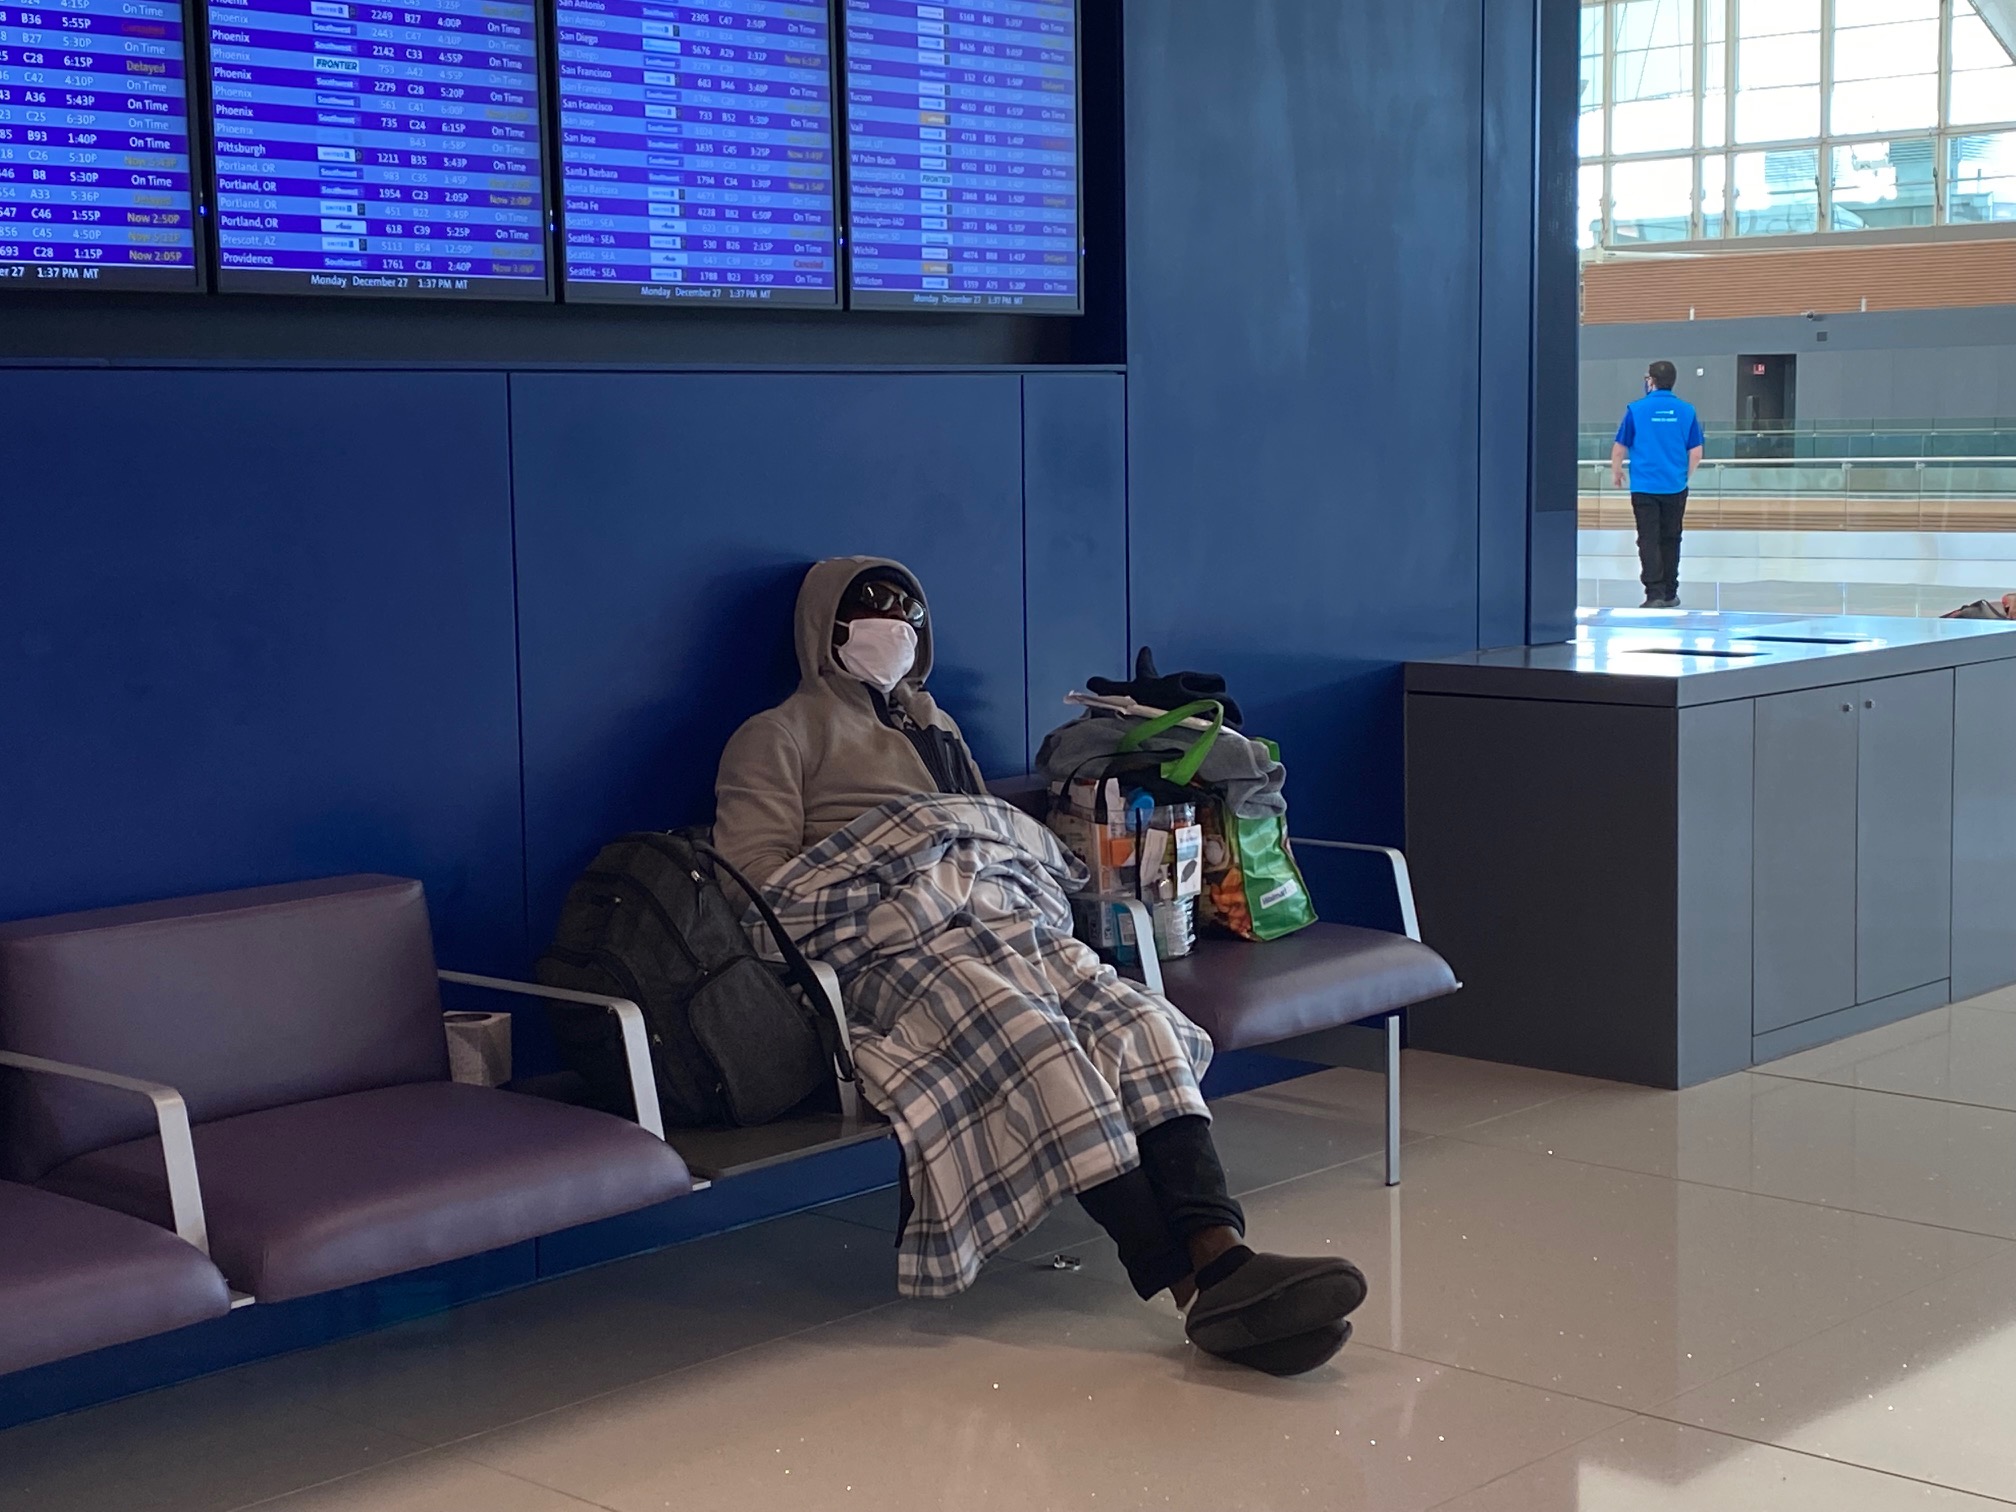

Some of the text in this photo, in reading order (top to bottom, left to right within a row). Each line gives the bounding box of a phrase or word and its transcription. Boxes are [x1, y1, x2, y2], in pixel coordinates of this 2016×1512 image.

[123, 4, 138, 14] On
[140, 5, 163, 16] Time
[212, 11, 248, 23] Phoenix
[21, 13, 91, 28] B36 5:55P
[372, 10, 394, 20] 2249
[488, 22, 500, 32] On
[501, 24, 520, 34] Time
[560, 31, 574, 40] San
[22, 32, 166, 54] B27 5:30P On Time
[212, 30, 250, 42] Phoenix
[373, 46, 394, 56] 2142
[406, 49, 422, 60] C33
[489, 57, 501, 66] On
[502, 58, 522, 69] Time
[23, 52, 44, 64] C28
[64, 56, 93, 68] 6:15P
[213, 48, 357, 70] Phoenix FRONTIER
[562, 65, 612, 78] San Francisco
[24, 72, 167, 92] C42 4:10P On Time
[214, 67, 252, 80] Phoenix
[374, 82, 396, 92] 2279
[408, 84, 424, 94] C28
[490, 92, 502, 102] On
[504, 93, 524, 104] Time
[215, 86, 252, 98] Phoenix
[25, 91, 168, 112] A36 5:43P On Time
[563, 99, 576, 108] San
[579, 100, 613, 112] Francisco
[26, 111, 168, 130] C25 6:30P On Time
[216, 104, 254, 116] Phoenix
[381, 118, 398, 128] 735
[410, 120, 426, 130] C24
[492, 126, 504, 136] On
[505, 127, 525, 138] Time
[217, 123, 254, 134] Phoenix
[28, 130, 170, 150] B93 1:40P On Time
[564, 133, 578, 142] San
[28, 150, 98, 163] C26 5:10P
[218, 142, 266, 157] Pittsburgh
[410, 154, 427, 165] B35
[493, 161, 506, 170] On
[506, 162, 526, 172] Time
[262, 163, 276, 172] OR
[565, 166, 618, 178] Santa Barbara
[32, 169, 172, 188] B8 5:30P On Time
[30, 189, 100, 202] A33 5:36P
[220, 179, 261, 192] Portland,
[263, 182, 276, 192] OR
[380, 188, 400, 198] 1954
[412, 190, 428, 200] C23
[264, 200, 277, 210] OR
[567, 200, 588, 210] Santa
[590, 202, 598, 210] Fe
[31, 208, 52, 219] C46
[72, 210, 100, 221] 1:55P
[127, 212, 150, 223] Now
[32, 228, 101, 240] C45 4:50P
[222, 216, 263, 228] Portland,
[265, 218, 278, 228] OR
[414, 226, 430, 235] C39
[496, 230, 508, 238] On
[509, 230, 529, 240] Time
[568, 233, 594, 244] Seattle
[601, 236, 615, 244] SEA
[33, 246, 54, 258] C28
[74, 248, 102, 259] 1:15P
[129, 250, 152, 260] Now
[224, 252, 274, 264] Providence
[415, 260, 432, 270] C28
[11, 266, 99, 278] 27 1:37 PM MT
[602, 268, 616, 278] SEA
[310, 274, 468, 289] Monday December 27 1:37 PM MT
[641, 287, 671, 298] Monday
